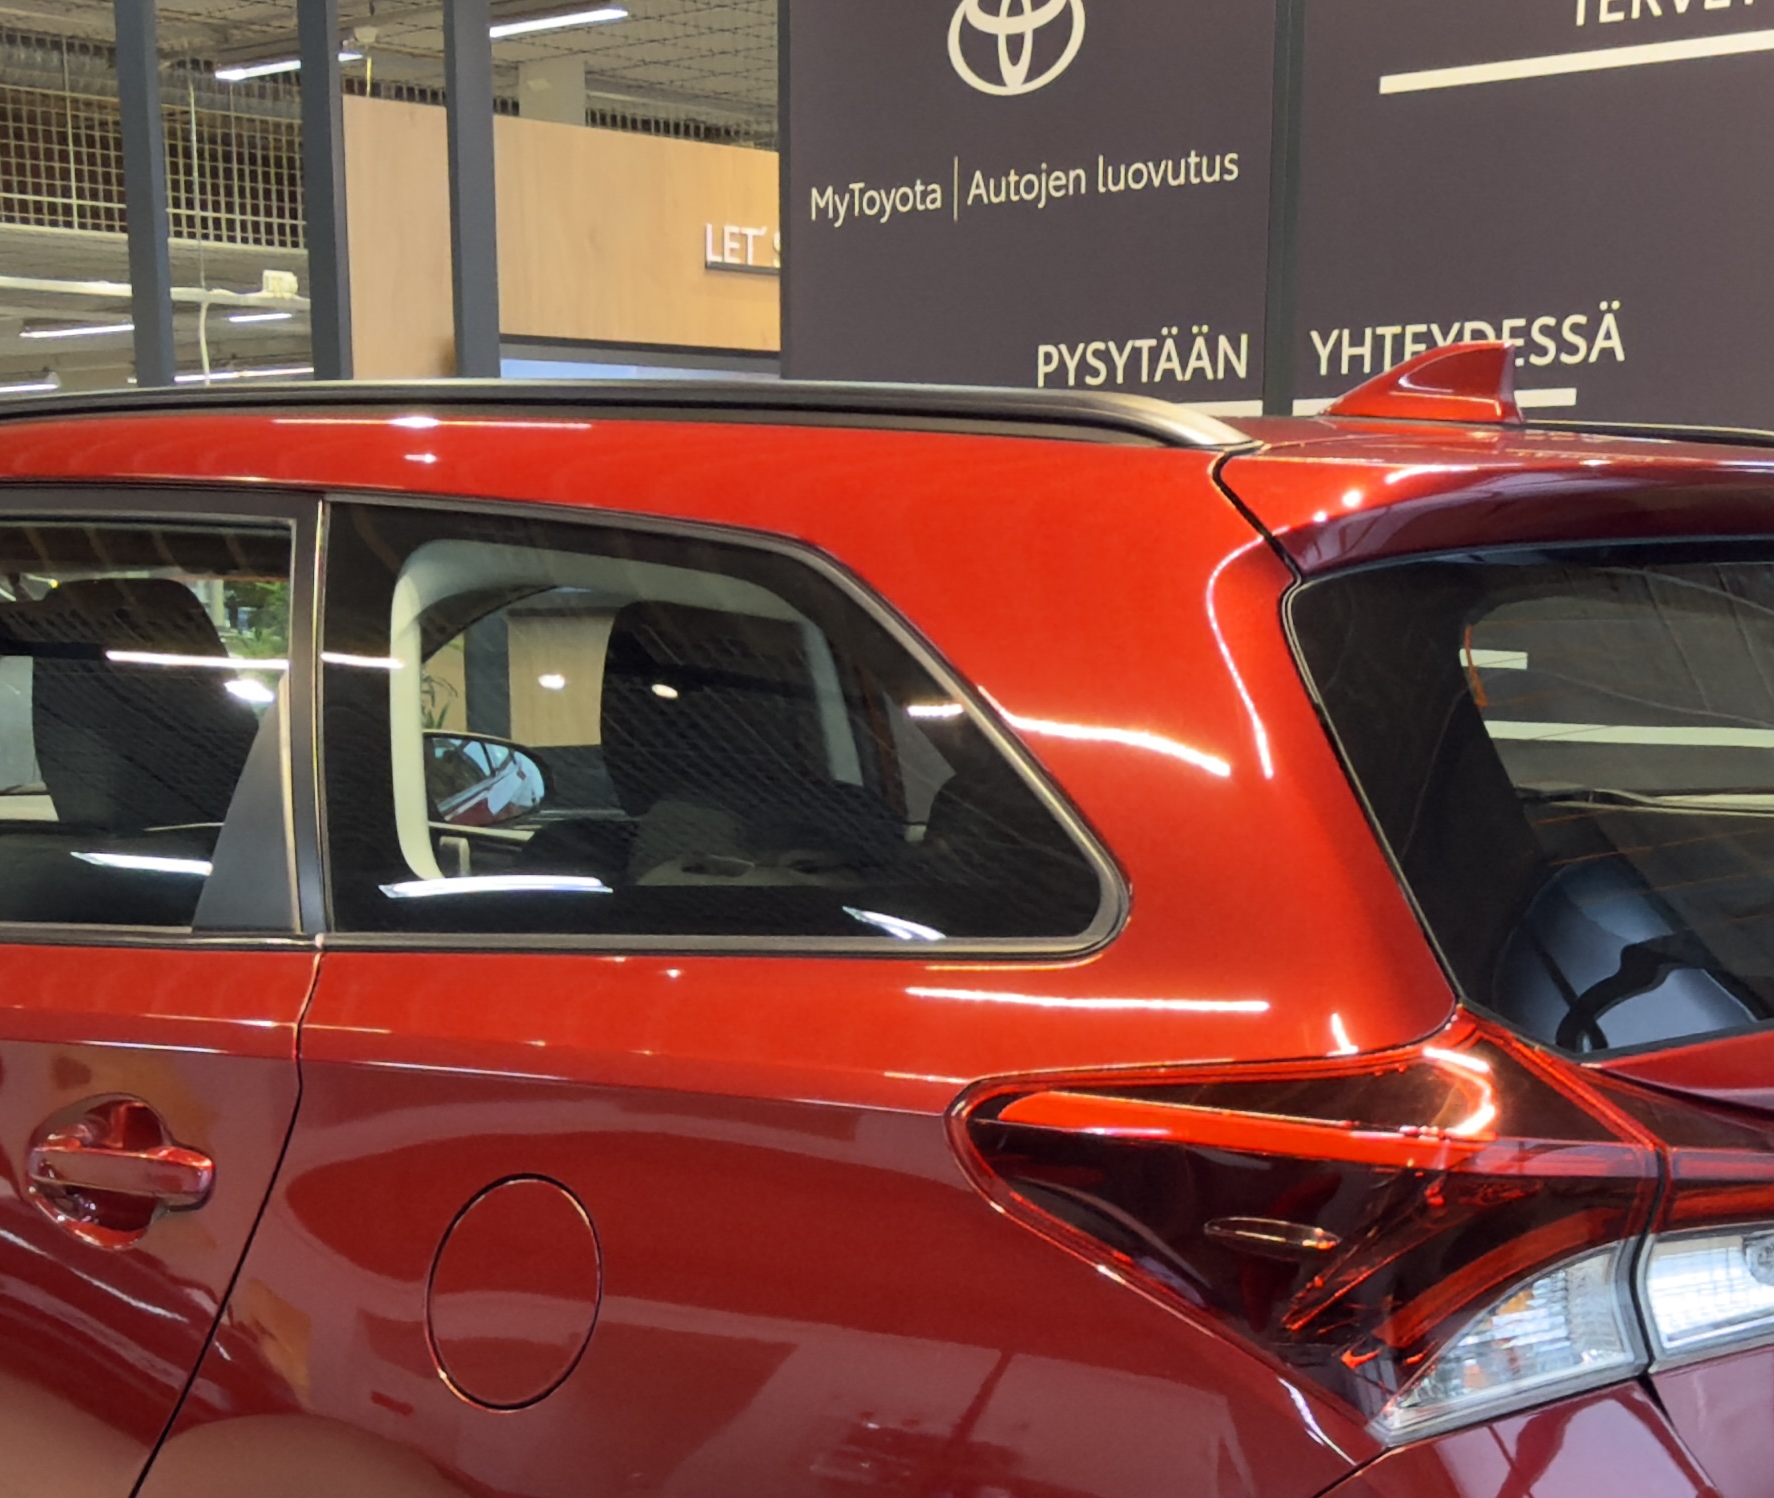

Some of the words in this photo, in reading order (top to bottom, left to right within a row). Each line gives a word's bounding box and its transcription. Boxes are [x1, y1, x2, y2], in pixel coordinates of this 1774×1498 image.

[810, 178, 942, 228] MyToyota
[967, 166, 1087, 209] Autojen
[1097, 149, 1240, 193] luovutus
[1036, 325, 1249, 388] PYSYTÄÄN
